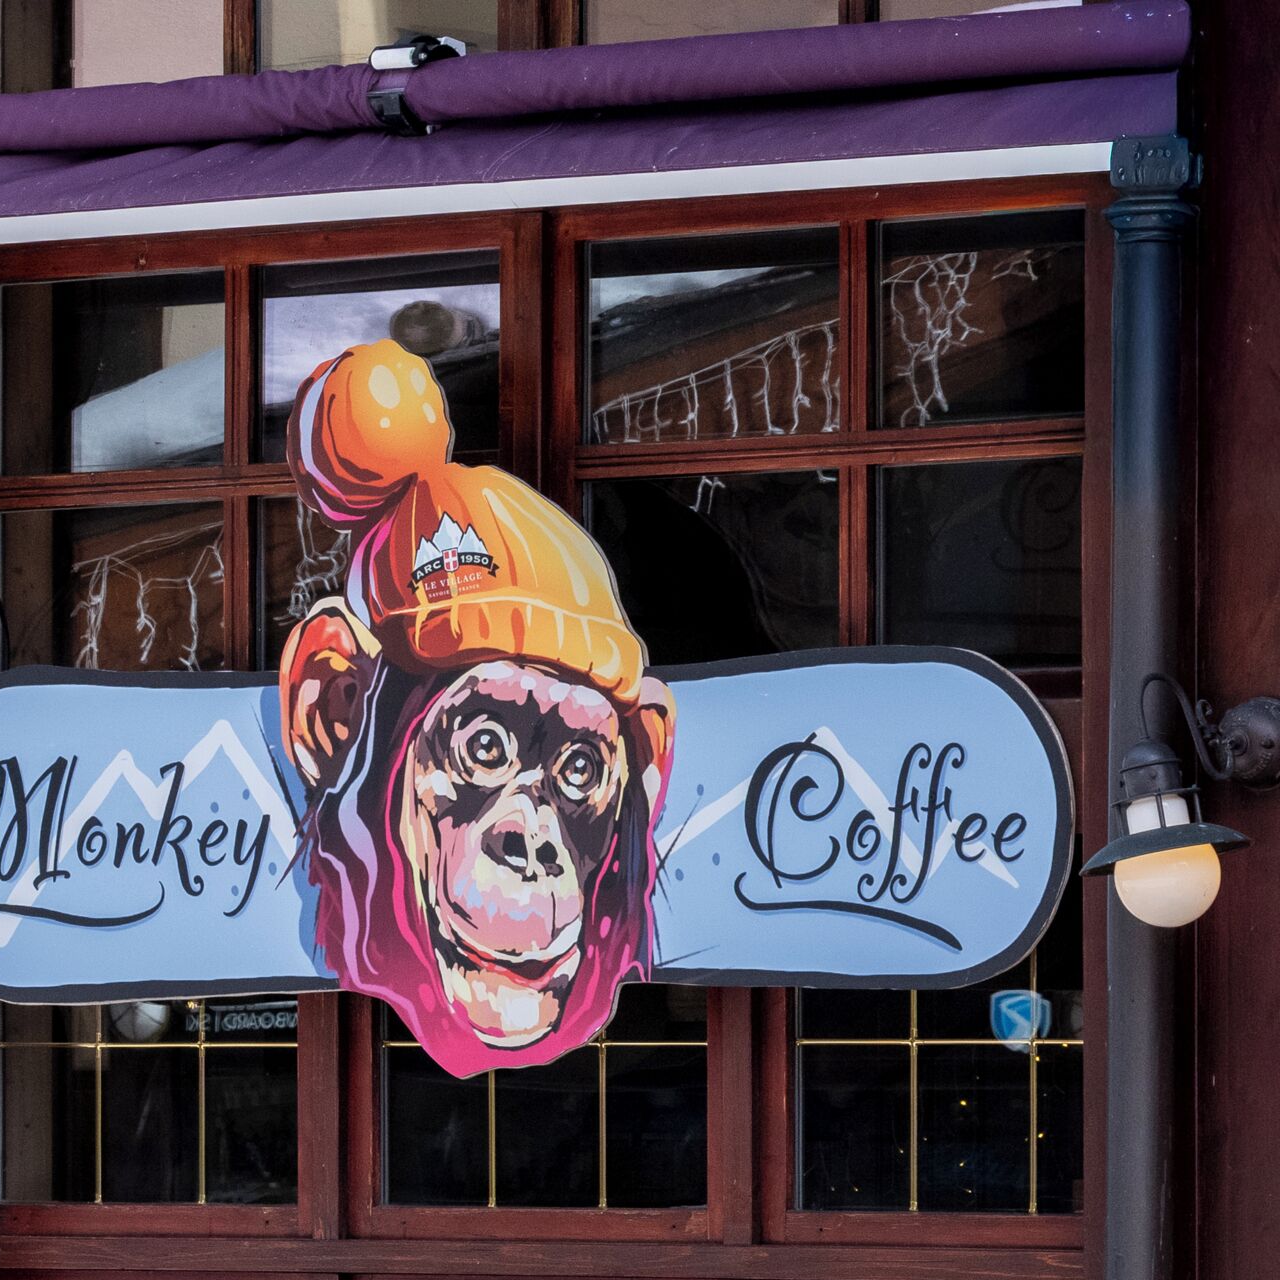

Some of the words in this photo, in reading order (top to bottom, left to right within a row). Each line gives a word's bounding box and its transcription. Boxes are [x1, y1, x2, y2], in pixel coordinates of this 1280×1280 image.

[416, 561, 441, 579] ARC
[460, 555, 488, 566] 1950
[425, 580, 437, 591] LE
[744, 731, 1027, 903] Coffee
